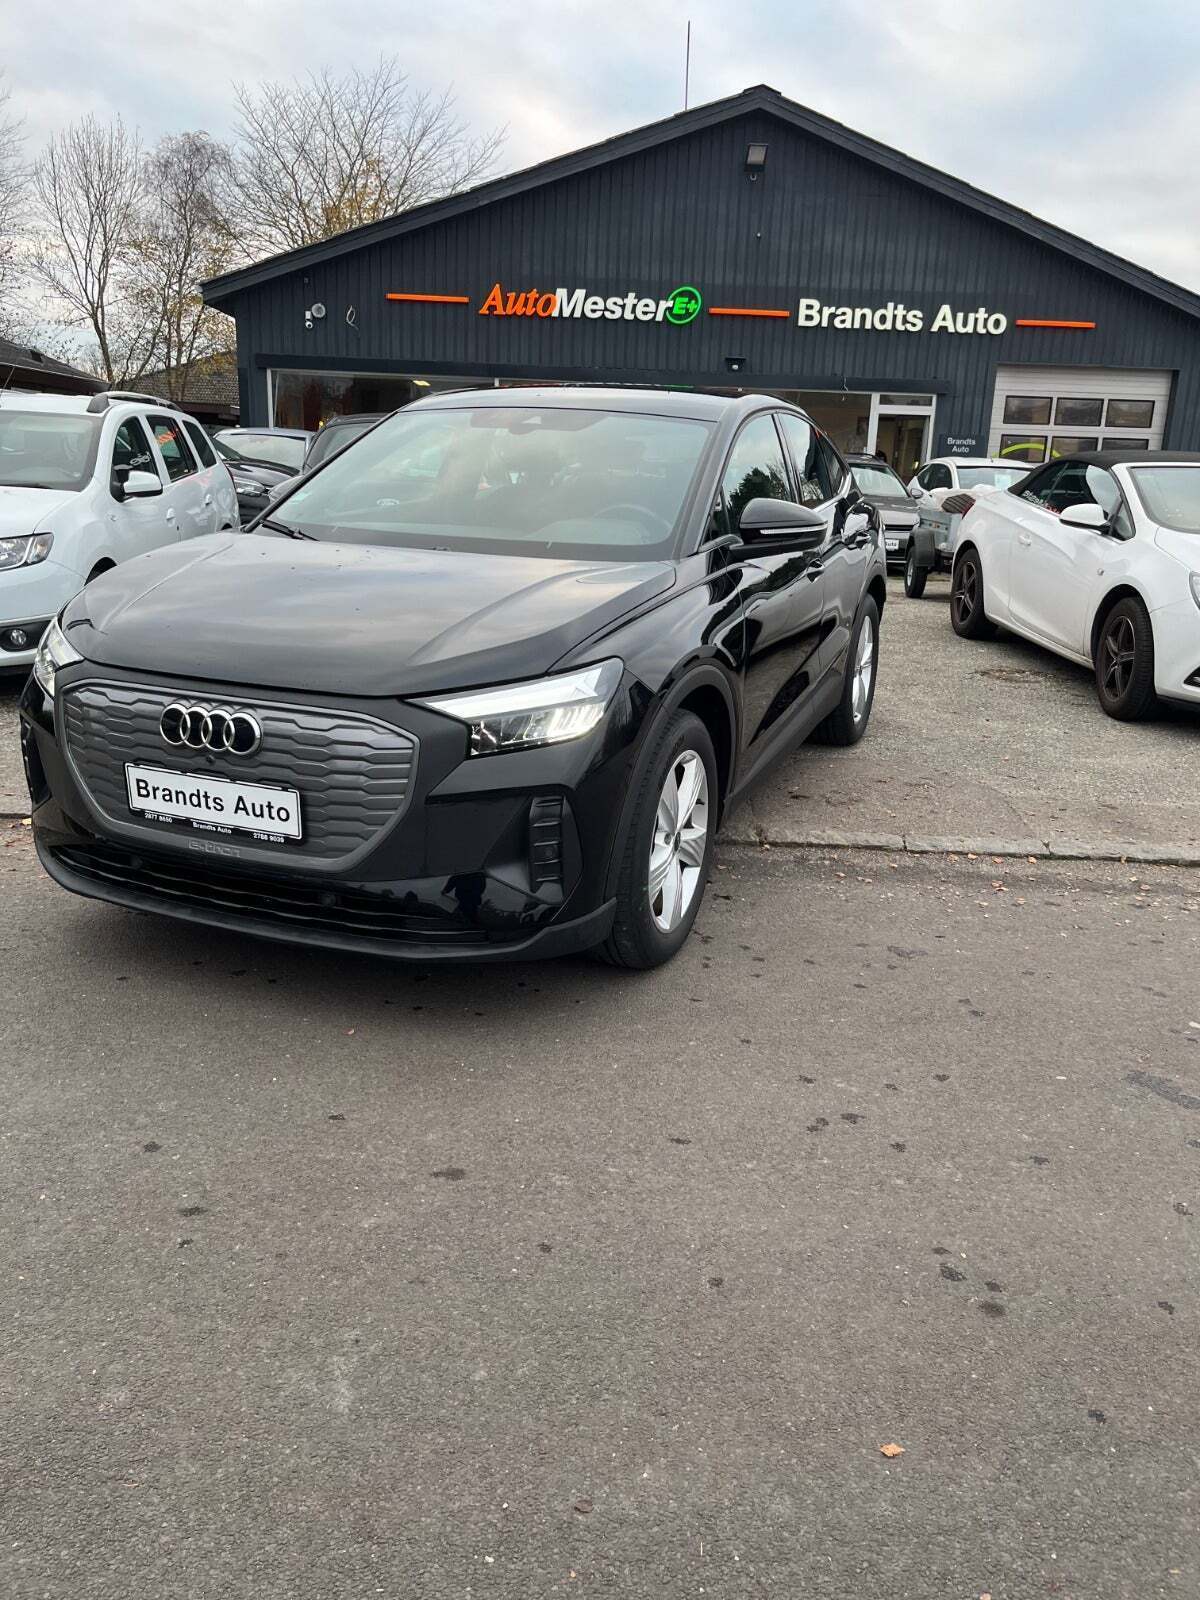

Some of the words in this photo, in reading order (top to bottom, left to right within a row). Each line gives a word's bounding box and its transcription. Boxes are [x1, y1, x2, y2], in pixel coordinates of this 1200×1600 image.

[479, 284, 673, 322] AutoMester
[797, 298, 923, 332] Brandts
[931, 304, 1007, 334] Auto
[136, 778, 225, 811] Brandts
[234, 796, 290, 822] Auto
[193, 822, 216, 832] Brandts
[217, 826, 232, 835] Auto
